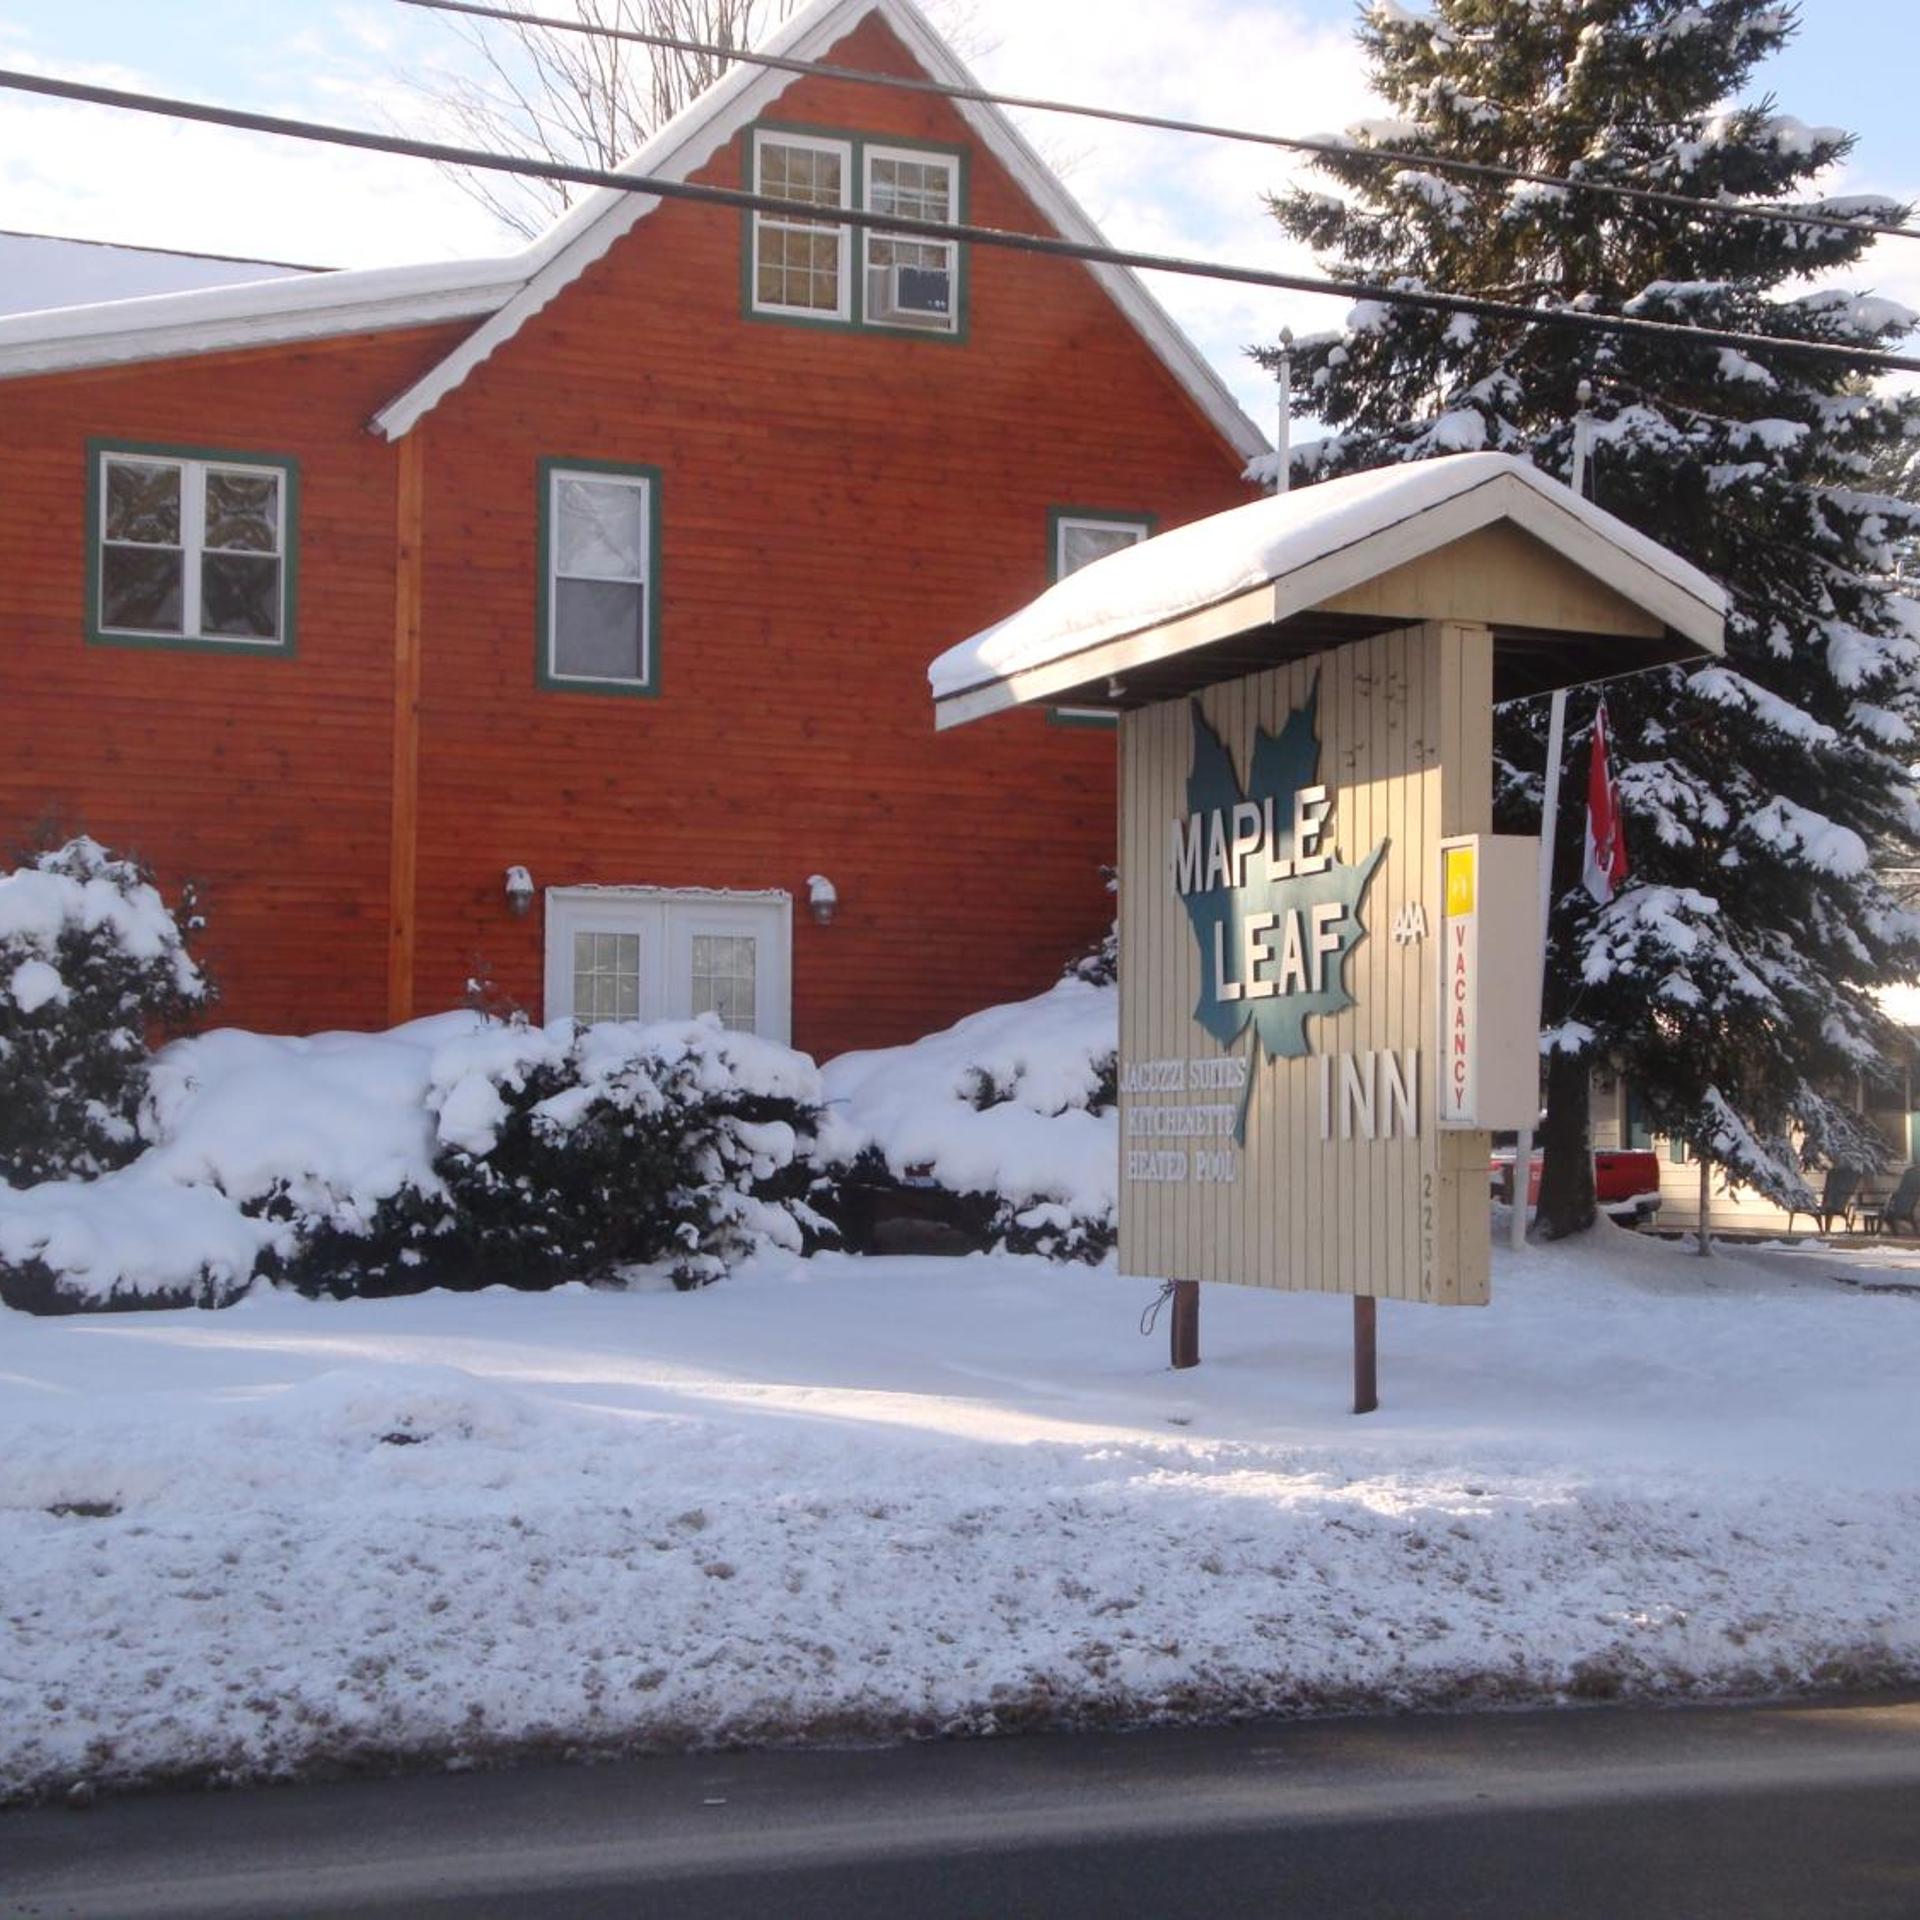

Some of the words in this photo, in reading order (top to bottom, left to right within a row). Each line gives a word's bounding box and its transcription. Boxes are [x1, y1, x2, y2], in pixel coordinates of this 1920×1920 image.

[1171, 784, 1328, 895] MAPLE
[1214, 902, 1344, 1001] LEAF
[1393, 900, 1426, 945] AAA
[1454, 924, 1467, 1111] VACANCY
[1120, 1059, 1185, 1092] JACUZZI
[1190, 1056, 1246, 1090] SUITES
[1321, 1048, 1419, 1140] INN
[1127, 1151, 1187, 1181] HEATED
[1195, 1151, 1236, 1182] POOL
